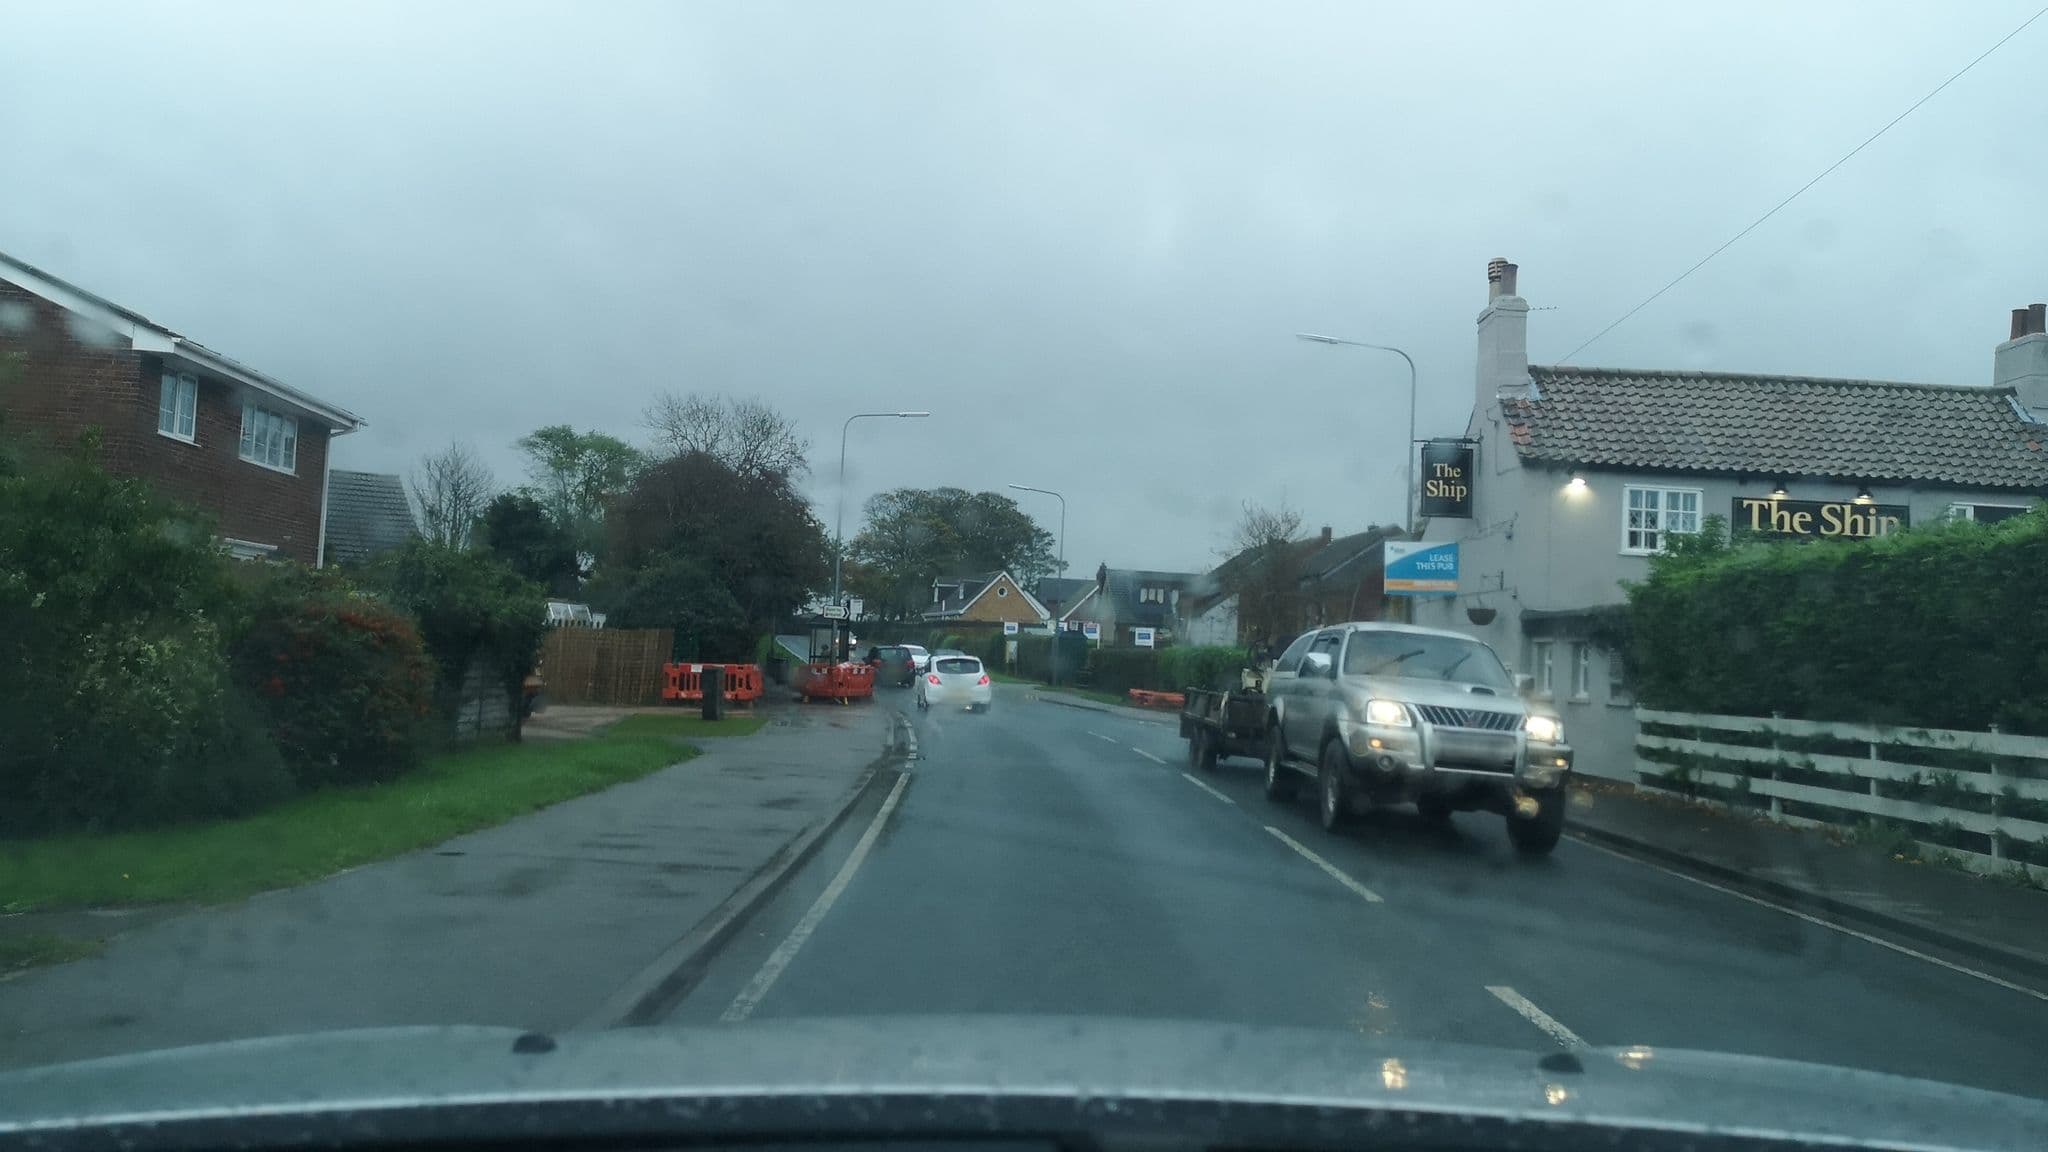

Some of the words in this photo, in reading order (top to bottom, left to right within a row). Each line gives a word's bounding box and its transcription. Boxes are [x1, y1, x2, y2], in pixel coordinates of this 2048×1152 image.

[1433, 463, 1461, 477] The
[1426, 480, 1467, 501] Ship
[1743, 500, 1812, 534] The
[1429, 553, 1454, 562] LEASE
[1416, 562, 1436, 570] THIS
[1437, 562, 1454, 570] PUB
